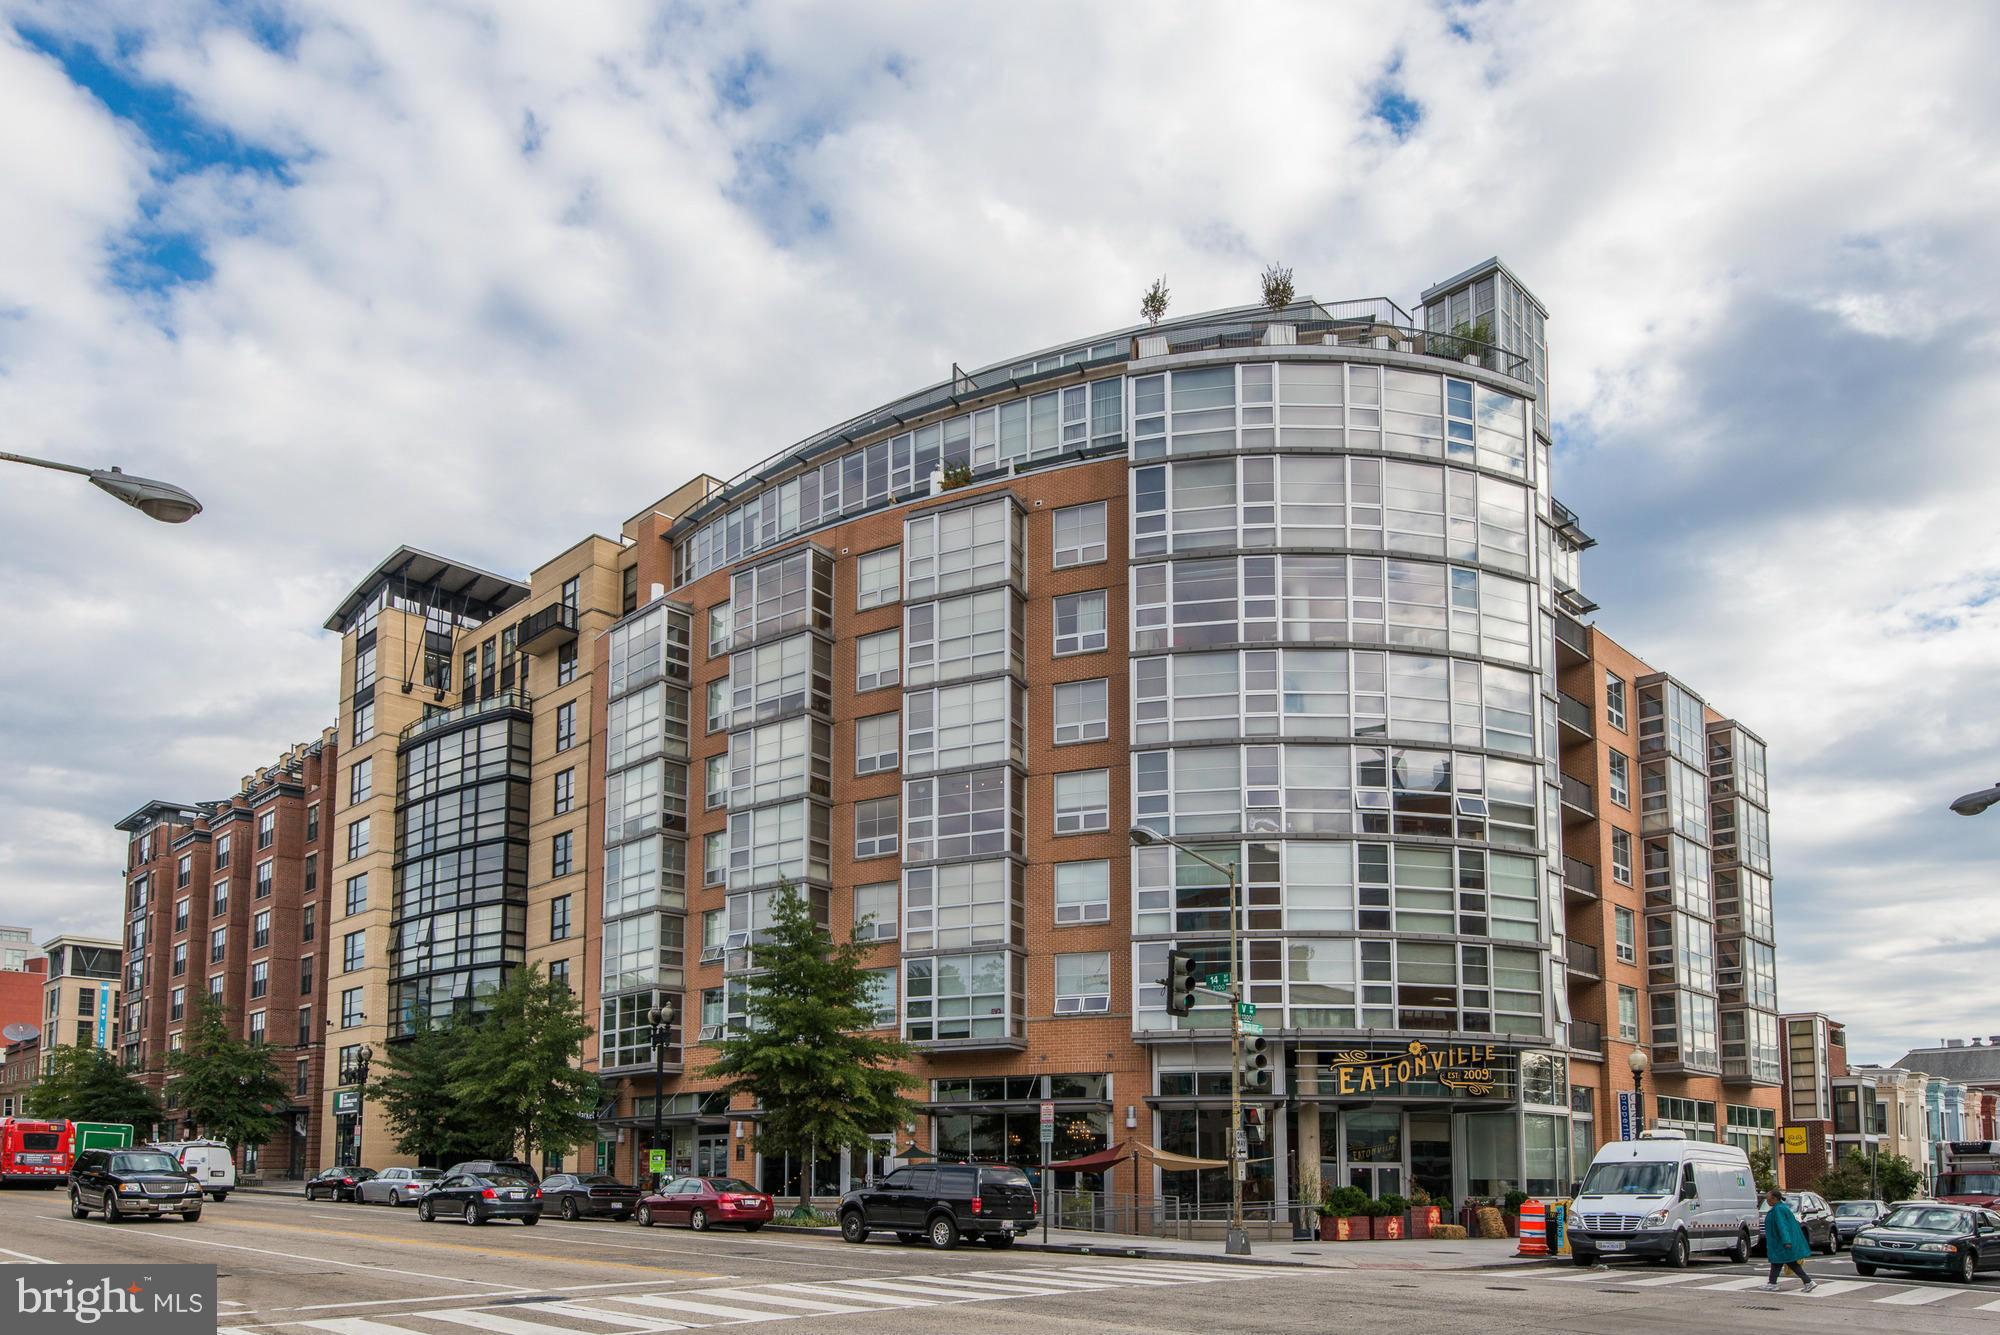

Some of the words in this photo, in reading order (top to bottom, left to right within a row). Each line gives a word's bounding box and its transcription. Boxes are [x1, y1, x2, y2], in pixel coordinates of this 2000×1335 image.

[1210, 976, 1218, 984] 14
[1241, 1004, 1246, 1013] V
[1339, 1045, 1496, 1095] EATONVILLE
[1464, 1069, 1489, 1080] 2009
[1621, 1094, 1630, 1141] propertie
